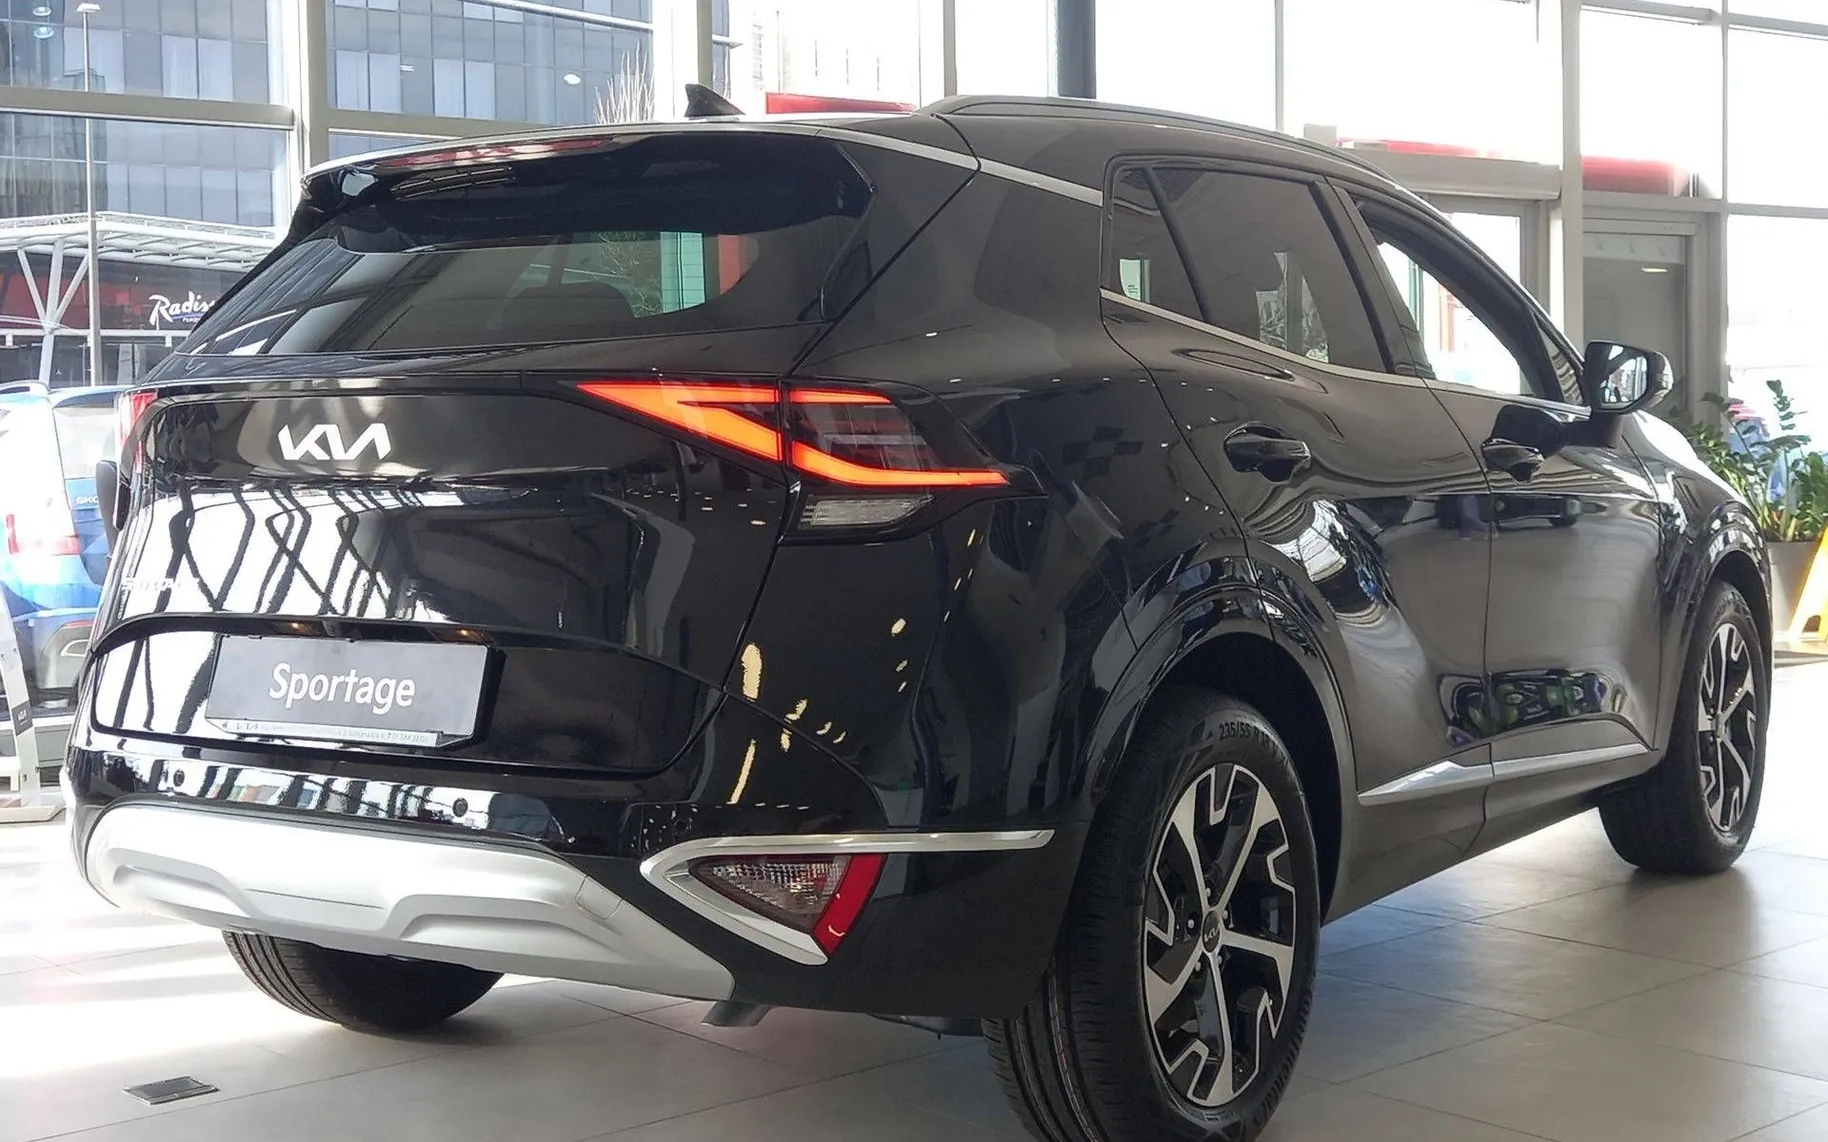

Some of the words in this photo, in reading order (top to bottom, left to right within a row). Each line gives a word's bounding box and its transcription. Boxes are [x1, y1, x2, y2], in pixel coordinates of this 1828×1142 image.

[278, 423, 391, 460] KIA
[269, 662, 415, 715] Sportage
[1219, 721, 1251, 739] 235/55
